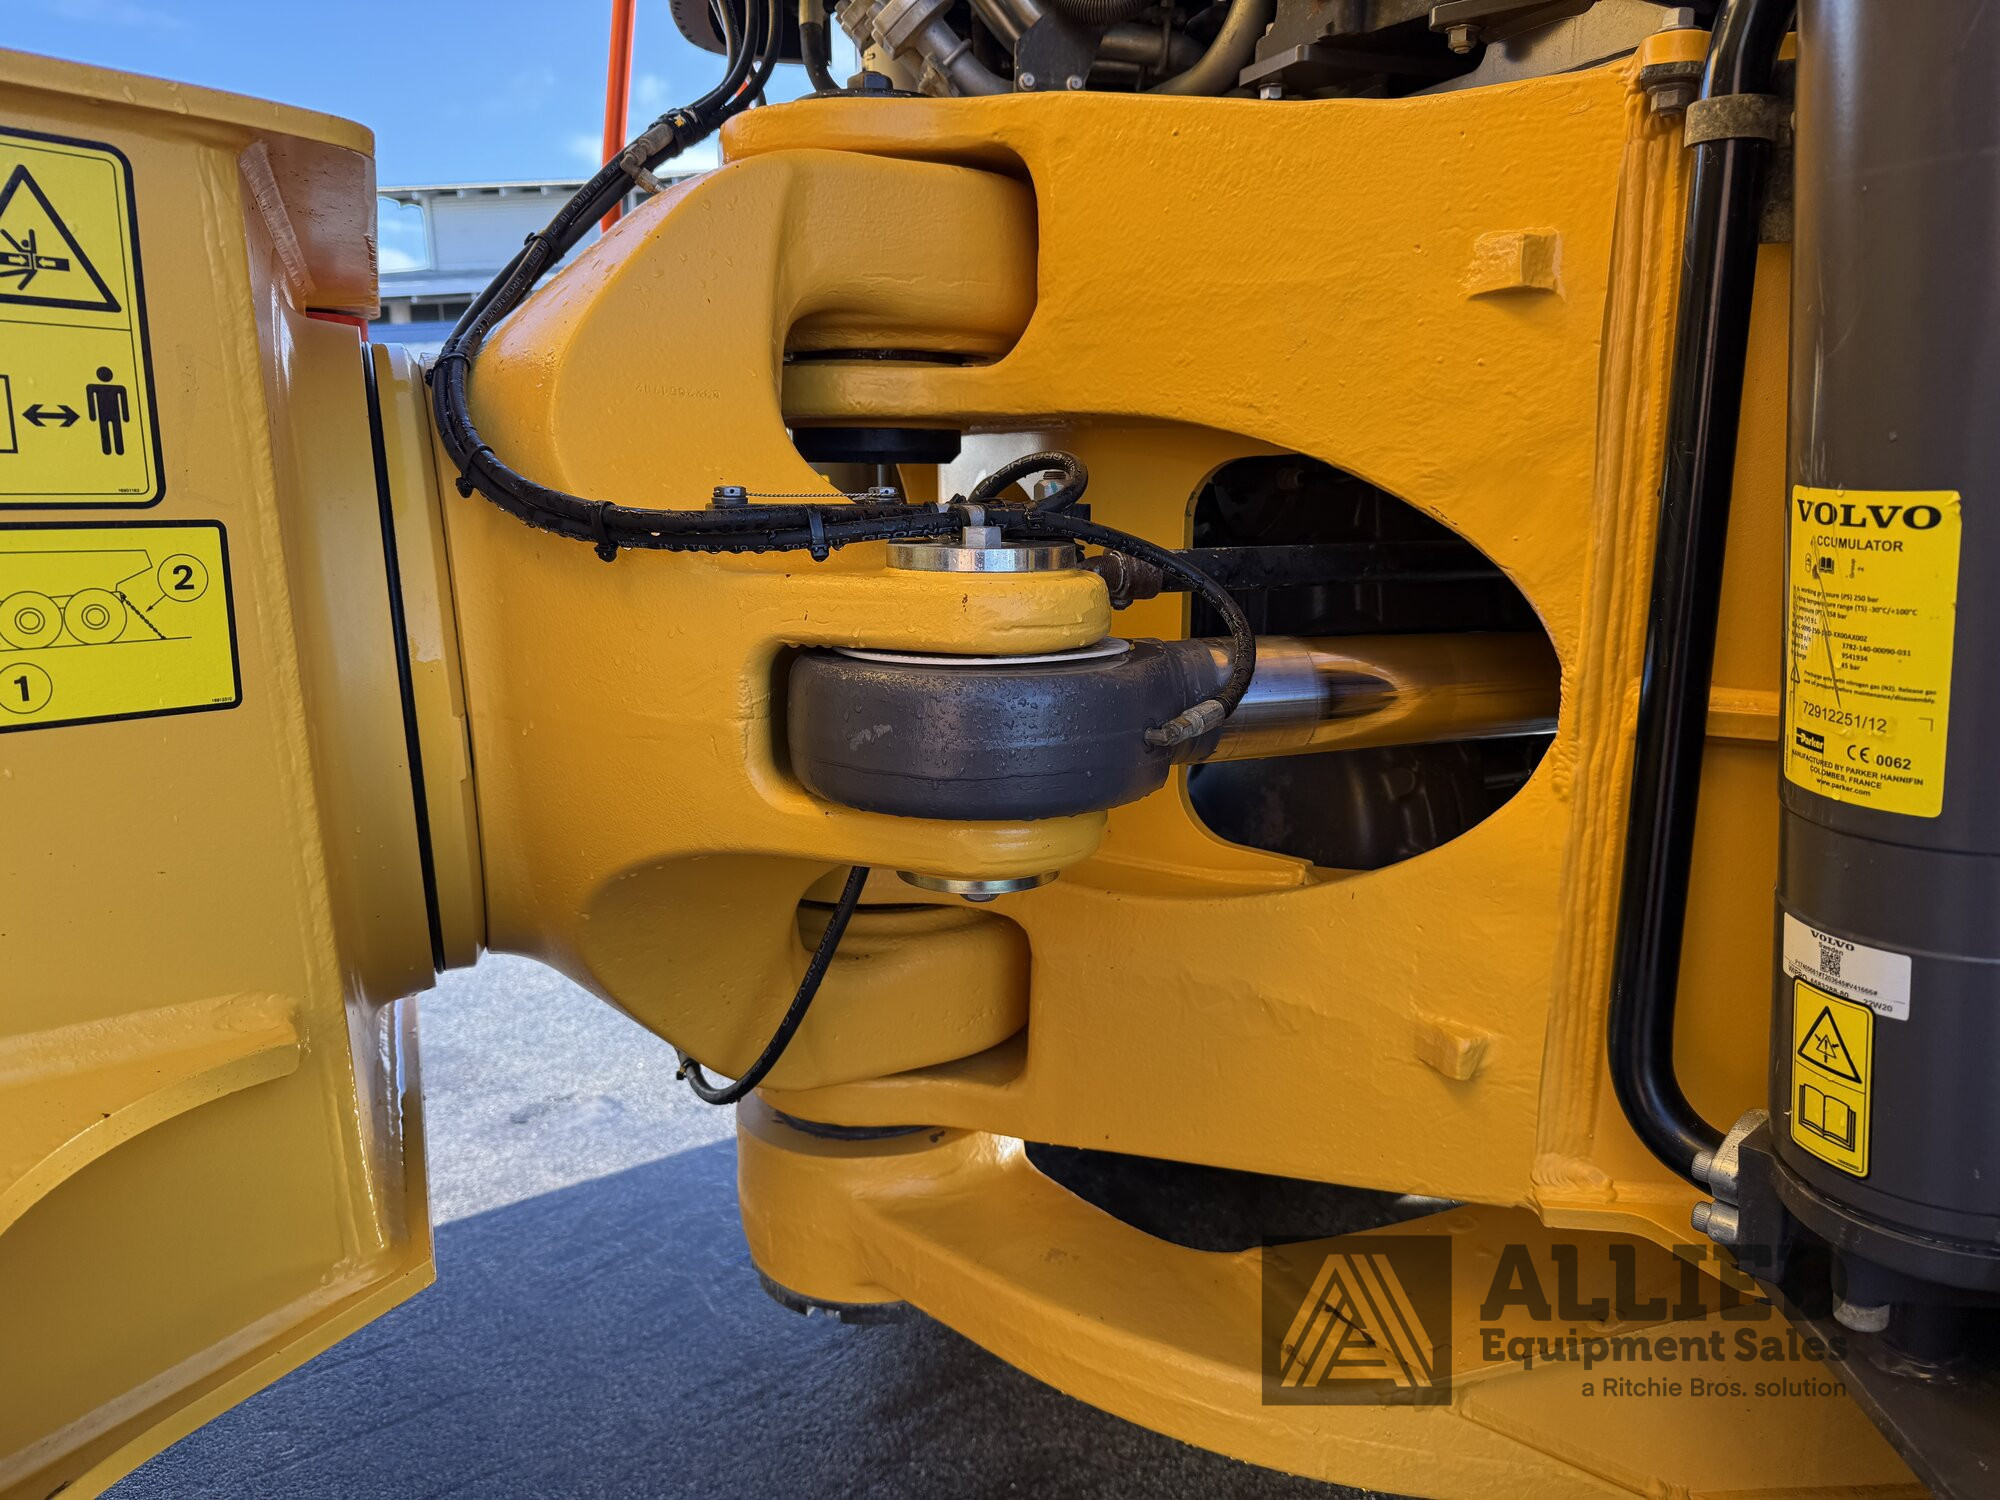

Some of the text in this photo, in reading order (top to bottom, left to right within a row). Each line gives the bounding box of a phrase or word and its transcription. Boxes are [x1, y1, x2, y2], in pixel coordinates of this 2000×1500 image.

[1797, 499, 1942, 530] VOLVO
[1810, 535, 1904, 552] CCUMULATOR
[172, 564, 195, 590] 2
[1201, 590, 1217, 604] bar
[1837, 603, 1853, 611] range
[1849, 663, 1861, 671] bar
[13, 675, 30, 702] 1
[1803, 701, 1887, 733] 72912251/12
[1800, 732, 1824, 750] Parker
[1792, 749, 1924, 786] MANUFACTURED BY PARKER HANNIFIN
[1876, 754, 1911, 770] 0062
[1810, 765, 1882, 790] COLOMBES, FRANCE
[1816, 778, 1871, 797] www.parker.com
[1810, 929, 1855, 952] VOLVO
[1818, 941, 1844, 956] Sweden
